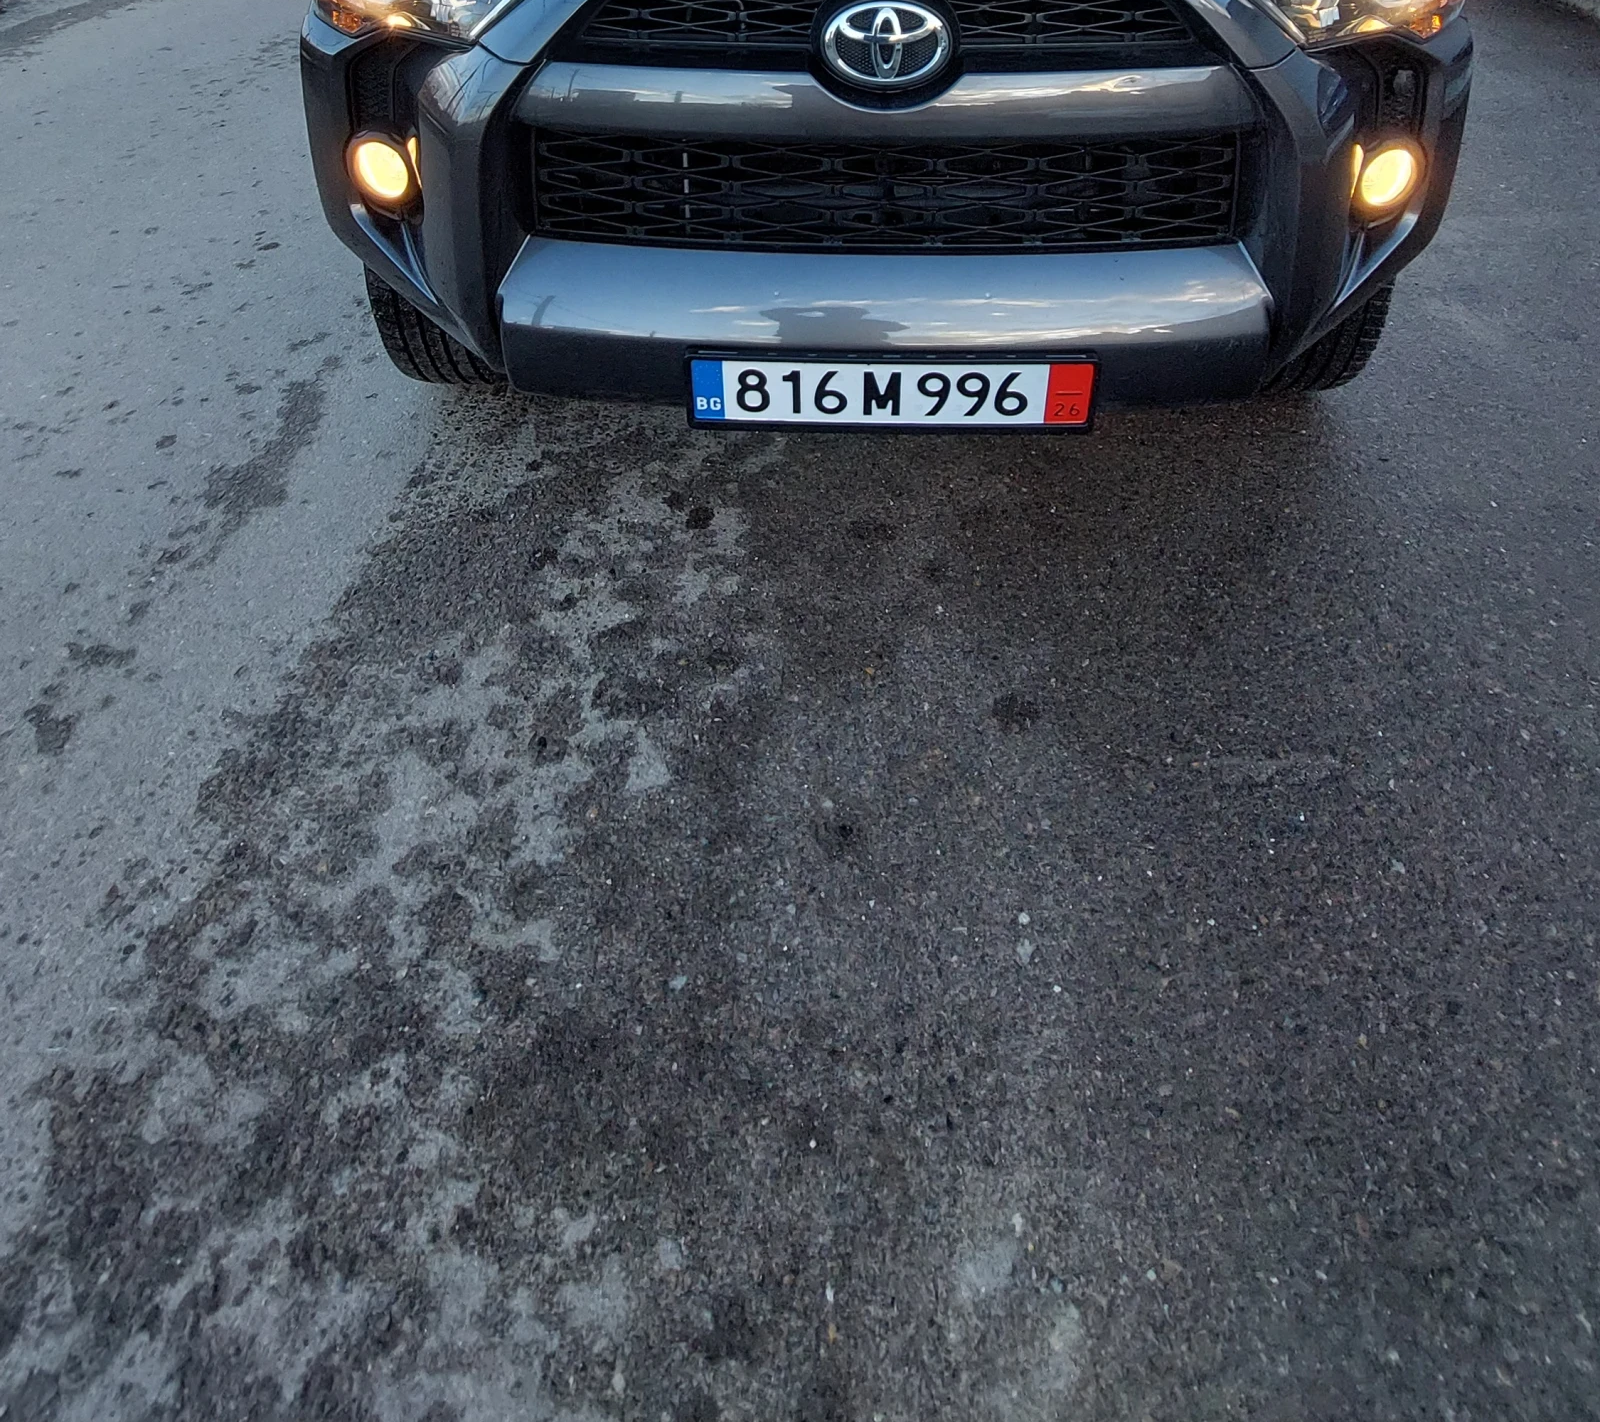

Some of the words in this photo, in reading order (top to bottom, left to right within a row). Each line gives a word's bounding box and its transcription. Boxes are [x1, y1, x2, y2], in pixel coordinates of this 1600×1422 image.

[736, 368, 848, 415] 816
[862, 372, 901, 416] M
[917, 372, 1029, 417] 996
[696, 397, 722, 411] BG
[1053, 402, 1081, 417] 26
